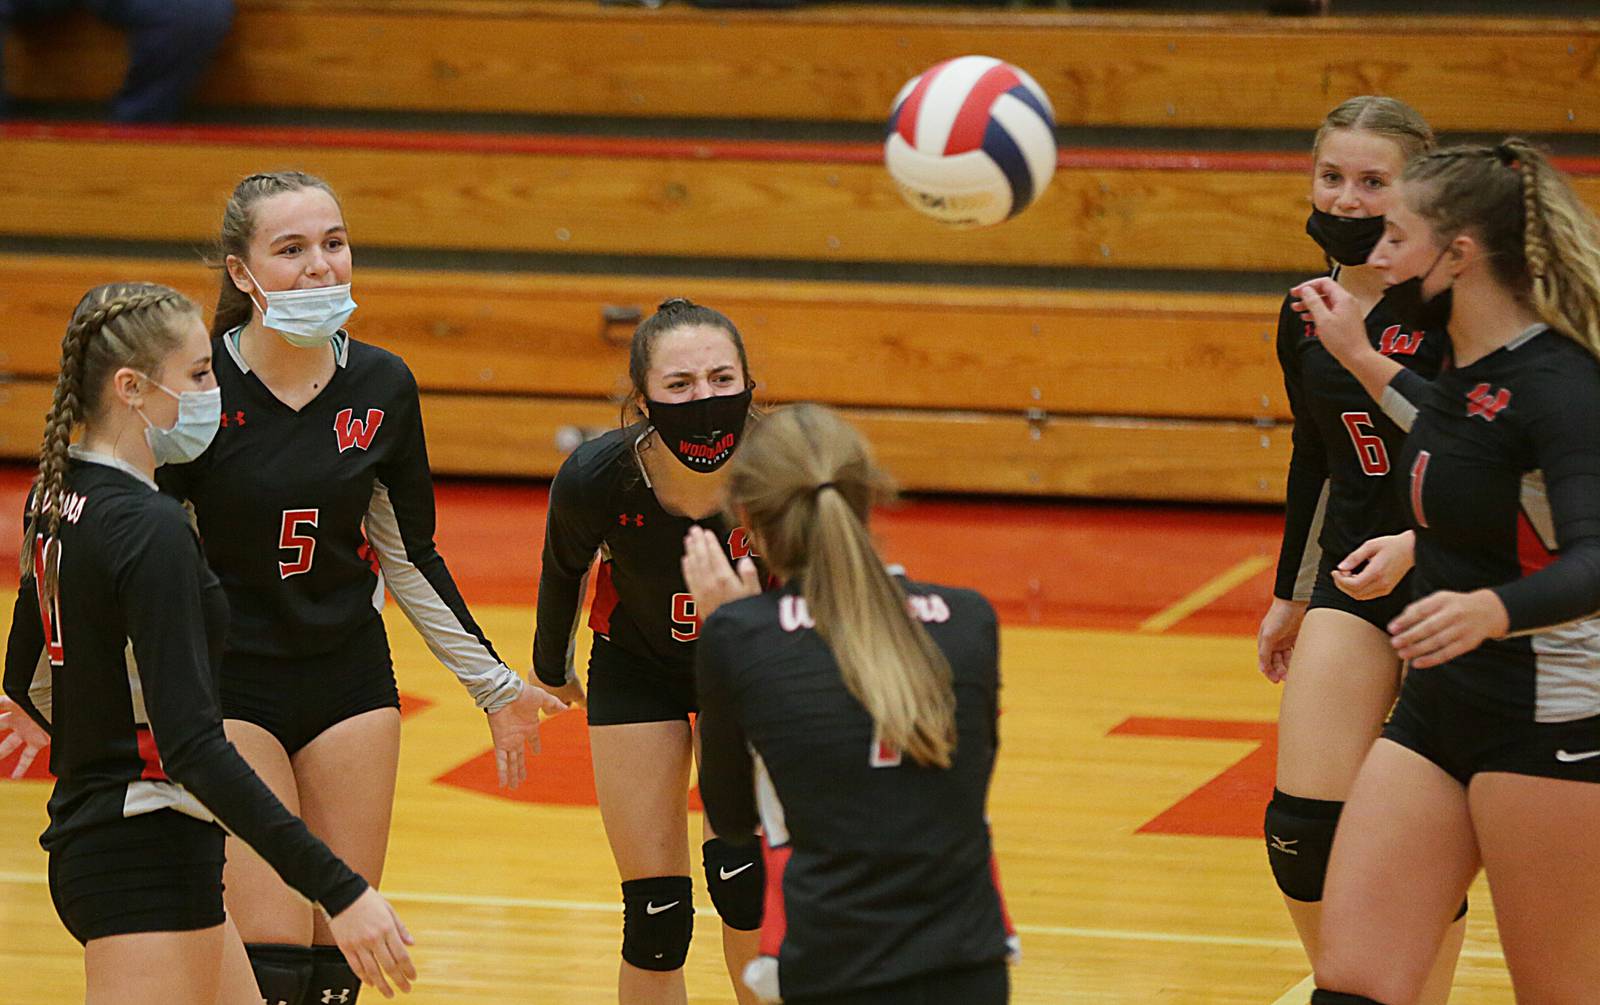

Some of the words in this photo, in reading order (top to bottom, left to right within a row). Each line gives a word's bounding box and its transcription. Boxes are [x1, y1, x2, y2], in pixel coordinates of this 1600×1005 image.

[1378, 324, 1425, 356] W
[1466, 383, 1512, 421] W
[333, 408, 385, 453] W
[1341, 412, 1391, 476] 6
[1410, 450, 1431, 528] 1
[278, 508, 319, 580] 5
[671, 592, 704, 642] 9
